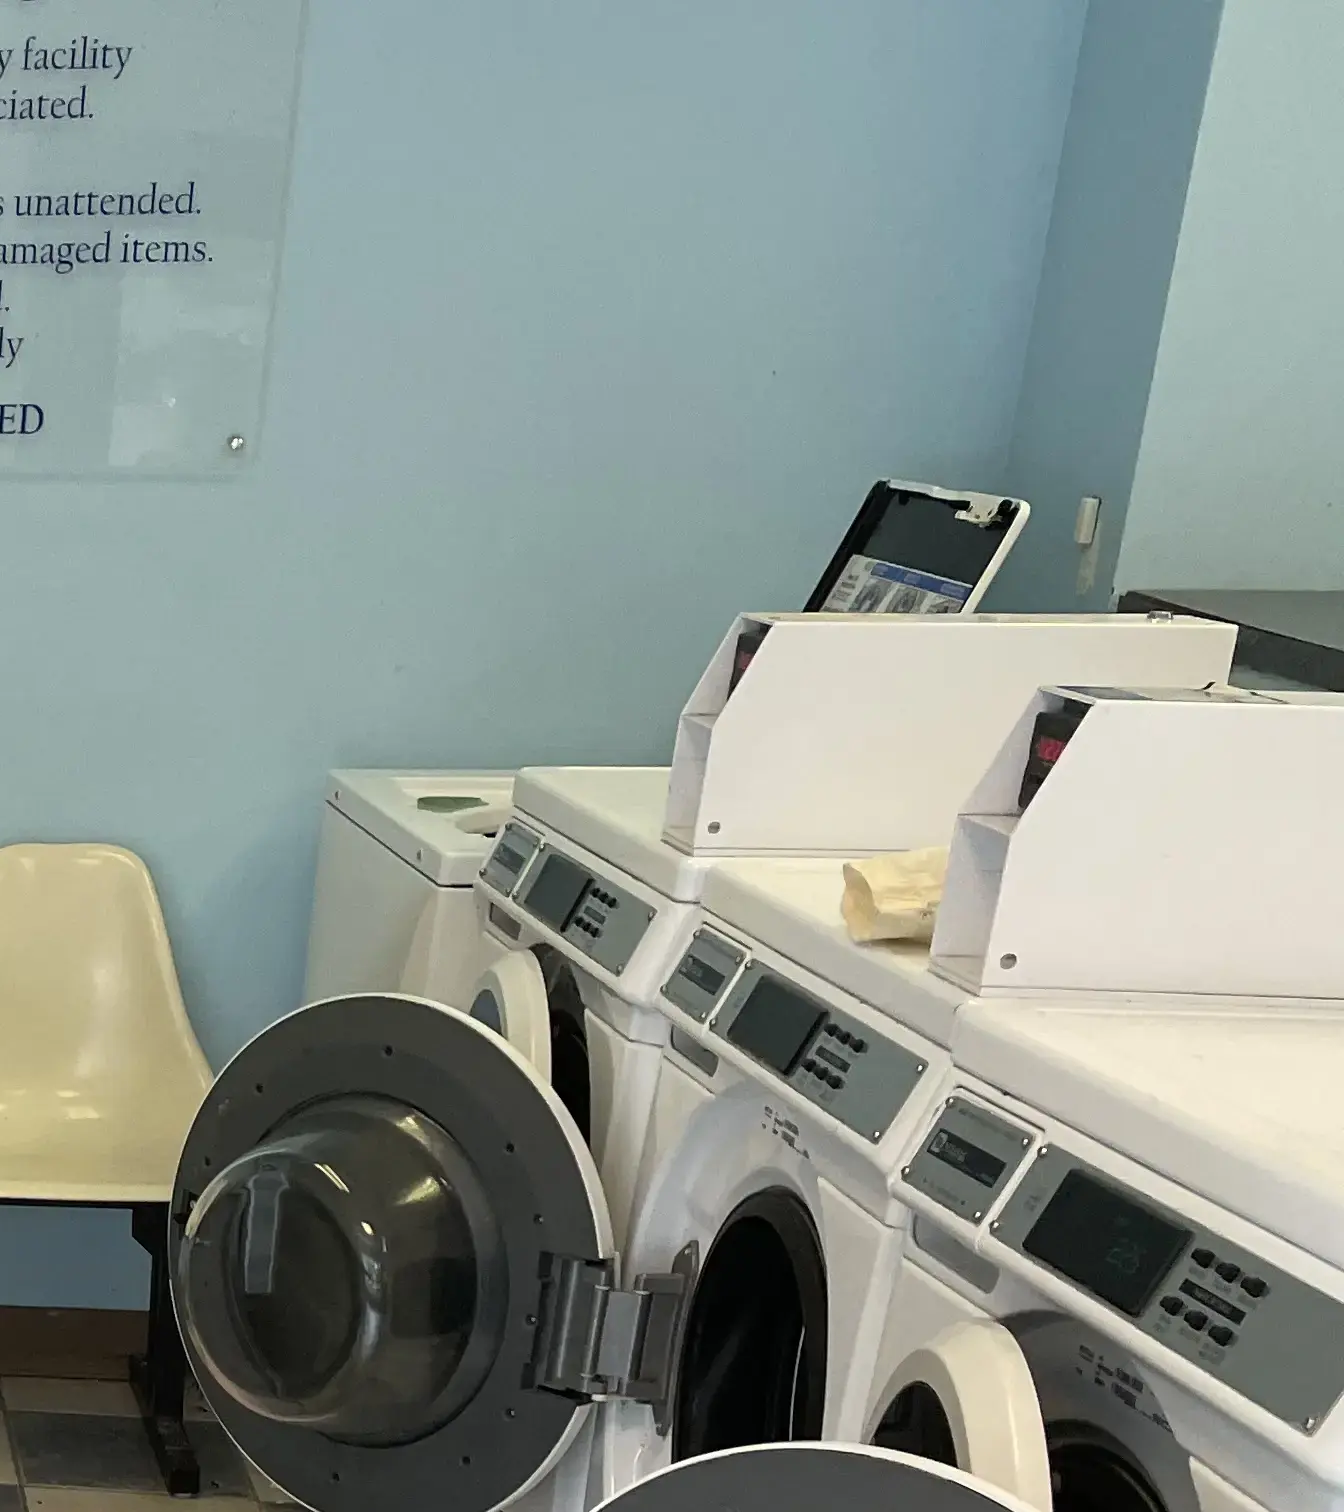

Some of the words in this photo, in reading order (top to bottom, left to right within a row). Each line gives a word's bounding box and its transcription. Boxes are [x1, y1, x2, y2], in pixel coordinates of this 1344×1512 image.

[23, 36, 133, 79] facility
[14, 182, 201, 217] unattended.
[119, 234, 213, 263] items.
